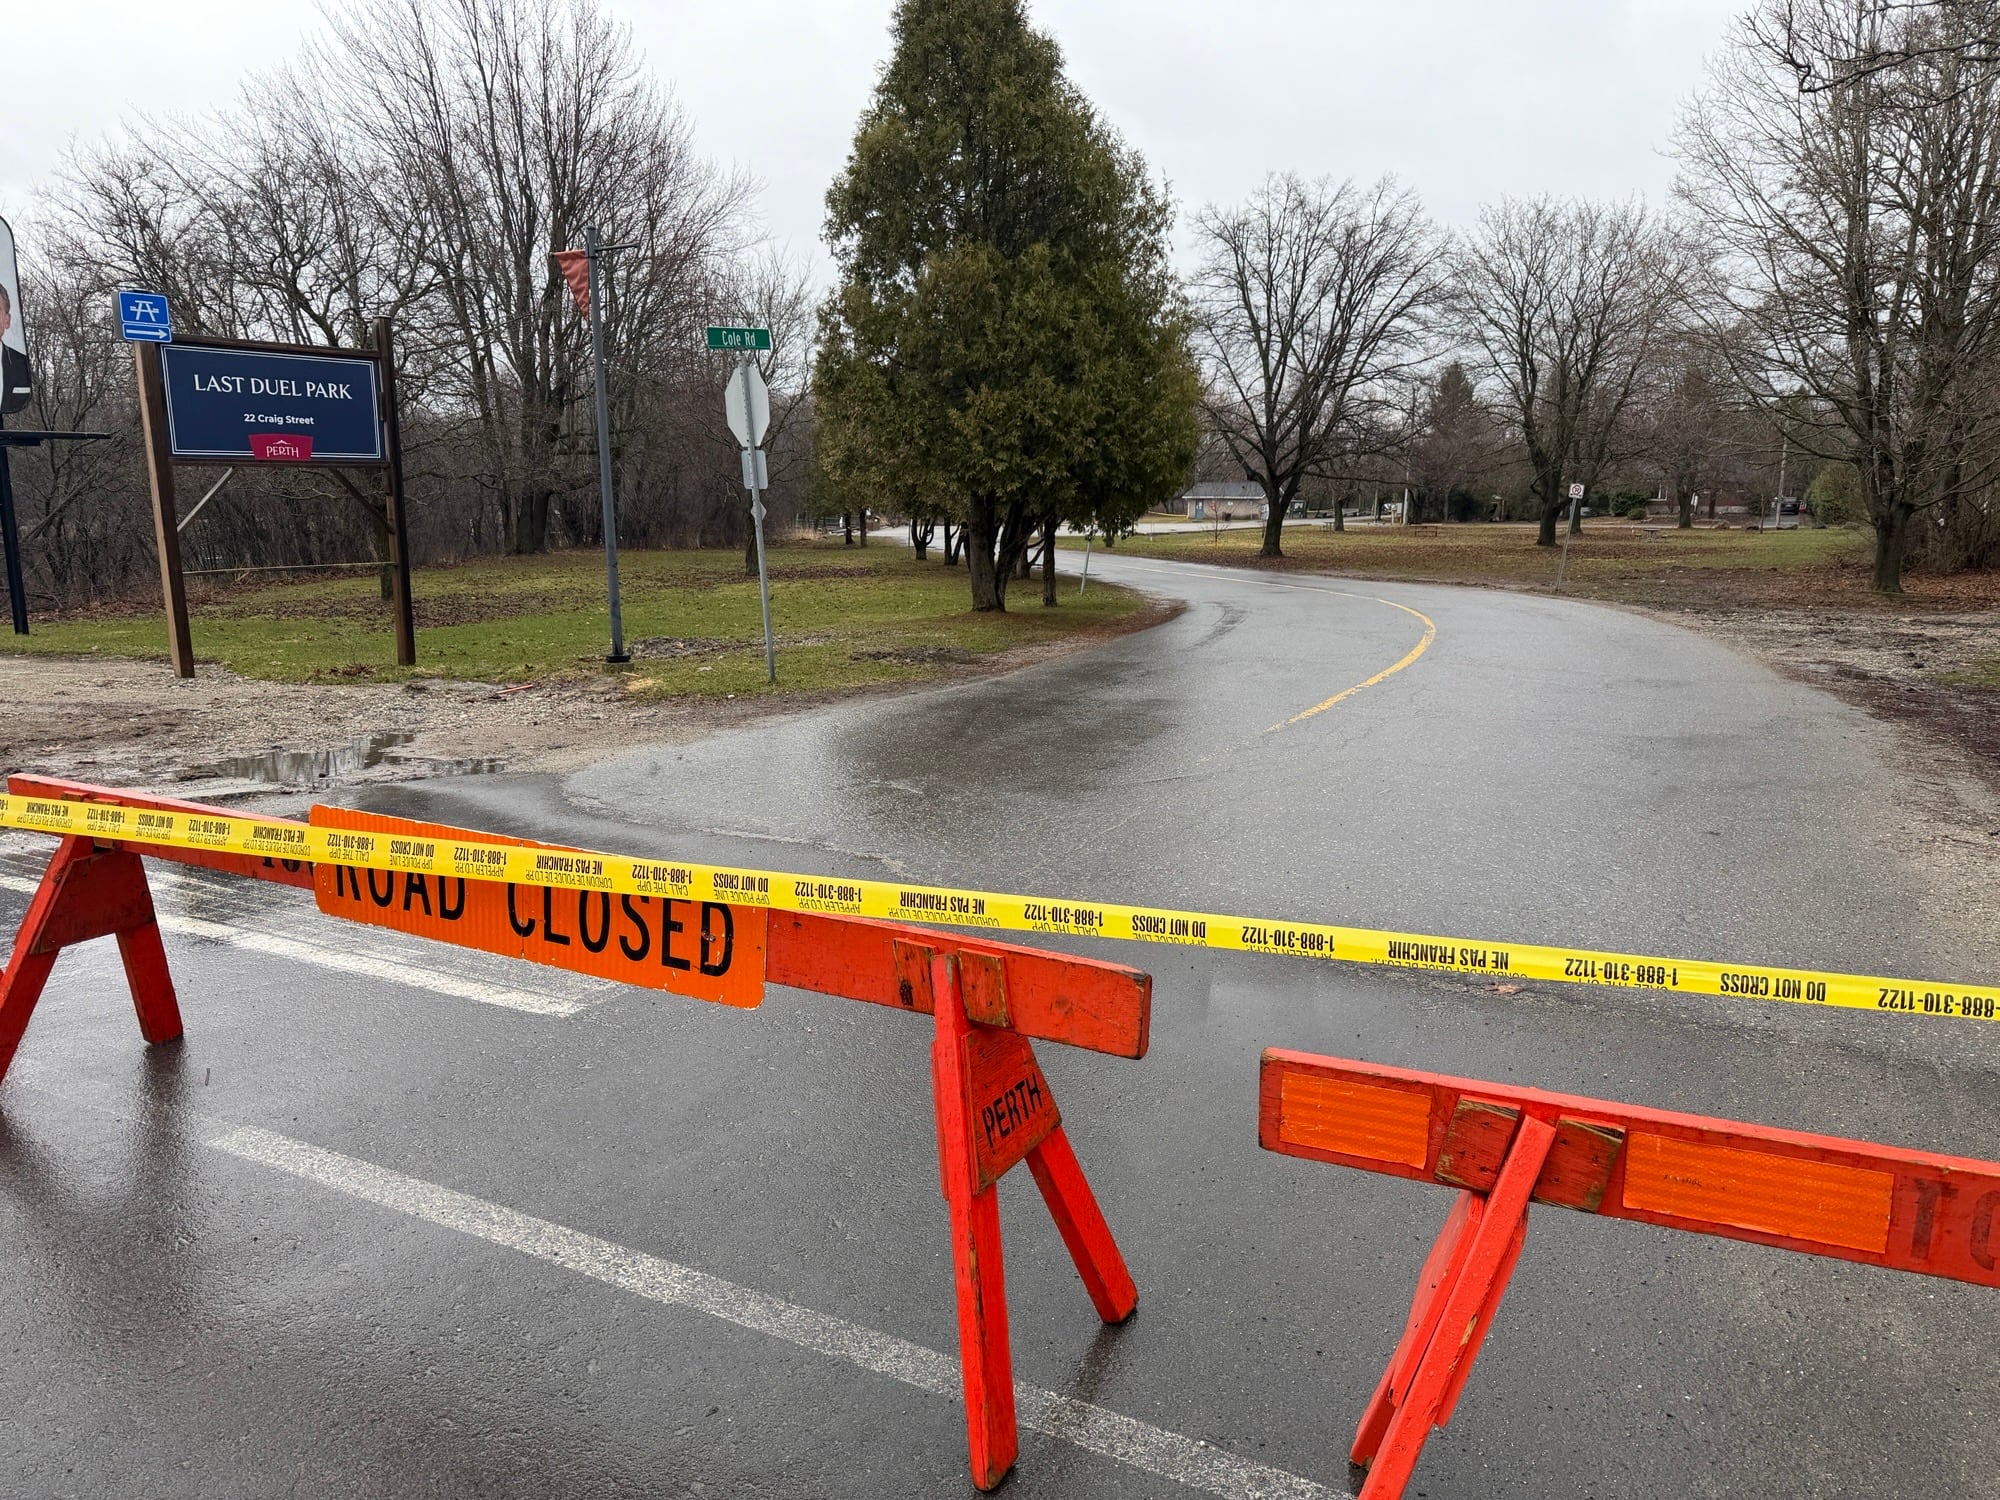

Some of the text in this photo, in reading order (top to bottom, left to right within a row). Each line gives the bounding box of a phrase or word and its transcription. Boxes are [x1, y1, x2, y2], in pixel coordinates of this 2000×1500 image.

[722, 330, 755, 346] Cole Rd
[194, 374, 352, 400] LAST DUEL PARK
[244, 414, 315, 425] 22 Craig Street
[266, 446, 299, 458] PERTH
[253, 826, 304, 843] NE PAS FRANCHIR
[327, 834, 374, 850] 1-888-310-1122
[343, 849, 353, 861] THE
[355, 850, 369, 862] CALL
[391, 840, 434, 857] DO NOT CROSS
[454, 847, 507, 866] 1-888-310-1122
[475, 864, 504, 877] APPELER
[536, 855, 602, 875] NE PAS FRANCHIR
[632, 864, 692, 884] 1-888-310-1122
[544, 871, 552, 882] DE
[554, 872, 576, 884] POLICE
[577, 875, 585, 885] DE
[586, 876, 612, 889] CORDON
[713, 873, 768, 892] DO NOT CROSS
[637, 880, 688, 896] CALL THE OPP
[713, 889, 770, 905] OPP POLICE LINE
[795, 881, 862, 902] 1-888-310-1122
[824, 900, 860, 914] APPELER
[900, 891, 985, 915] NE PAS FRANCHIR
[911, 910, 922, 920] DE
[924, 911, 952, 922] POLICE
[1024, 904, 1103, 927] 1-888-310-1122
[507, 882, 734, 977] CLOSED
[1132, 914, 1206, 938] DO NOT CROSS
[1242, 926, 1335, 952] 1-888-310-1122
[1388, 941, 1456, 964] FRANCHIR
[1460, 948, 1486, 968] PAS
[1492, 951, 1509, 970] NE
[1565, 958, 1679, 986] 1-888-310-1122
[1720, 973, 1768, 996] CROSS
[1773, 978, 1801, 999] NOT
[1806, 981, 1826, 1002] DO
[982, 1072, 1042, 1148] PERTH
